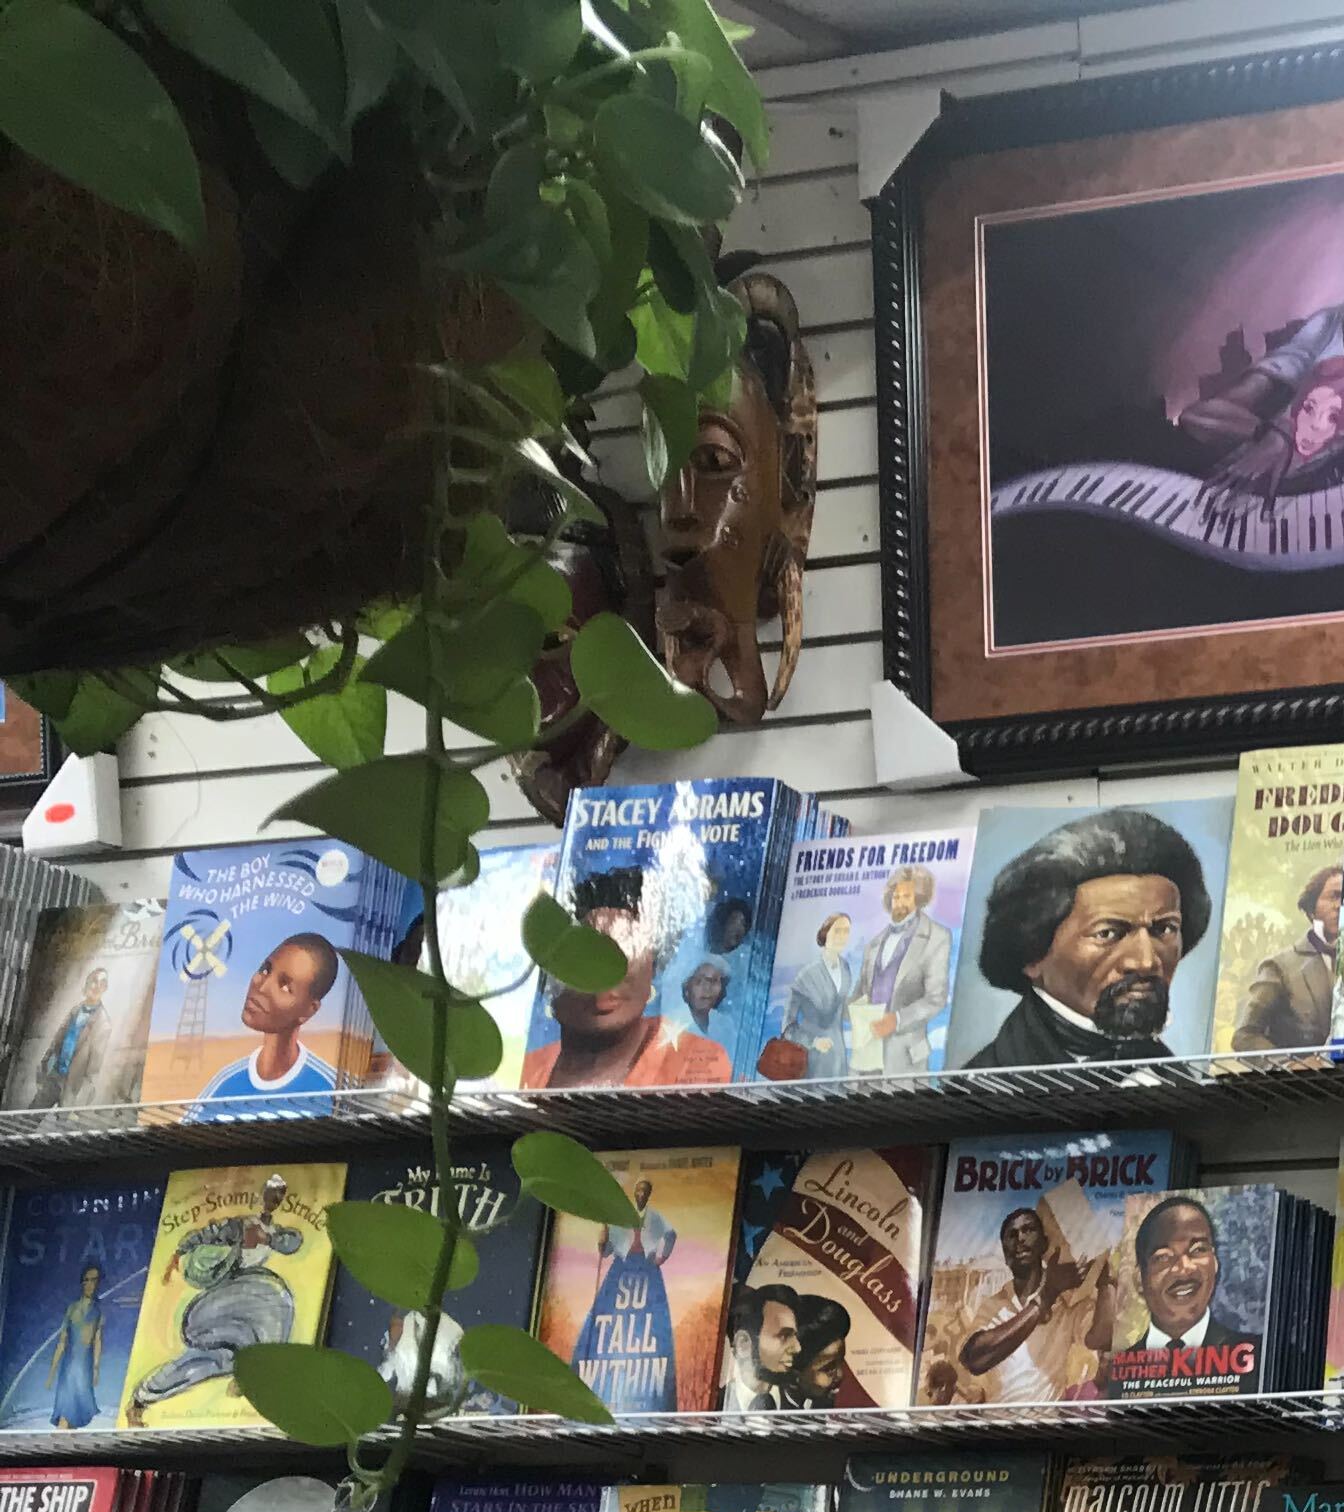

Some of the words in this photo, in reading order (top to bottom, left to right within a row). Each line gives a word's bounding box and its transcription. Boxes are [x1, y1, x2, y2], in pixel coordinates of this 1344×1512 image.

[574, 797, 662, 828] STACEY
[669, 791, 764, 822] ABRAMS
[795, 847, 853, 871] FRIENDS
[857, 844, 887, 866] FOR
[891, 839, 960, 862] FREEDOM
[954, 1155, 1042, 1192] BRICK
[1043, 1165, 1064, 1184] by
[1066, 1153, 1158, 1188] BRICK
[805, 1159, 908, 1241] Lincoln
[837, 1224, 863, 1246] and
[783, 1200, 902, 1315] Douglass
[1111, 1362, 1167, 1382] LUTHER
[1113, 1348, 1168, 1367] MARTIN
[1171, 1343, 1255, 1377] KING
[1123, 1378, 1140, 1389] THE
[1143, 1377, 1192, 1388] PEACEFUL
[1195, 1375, 1240, 1385] WARRIOR
[875, 1470, 1011, 1485] UNDERGROUND
